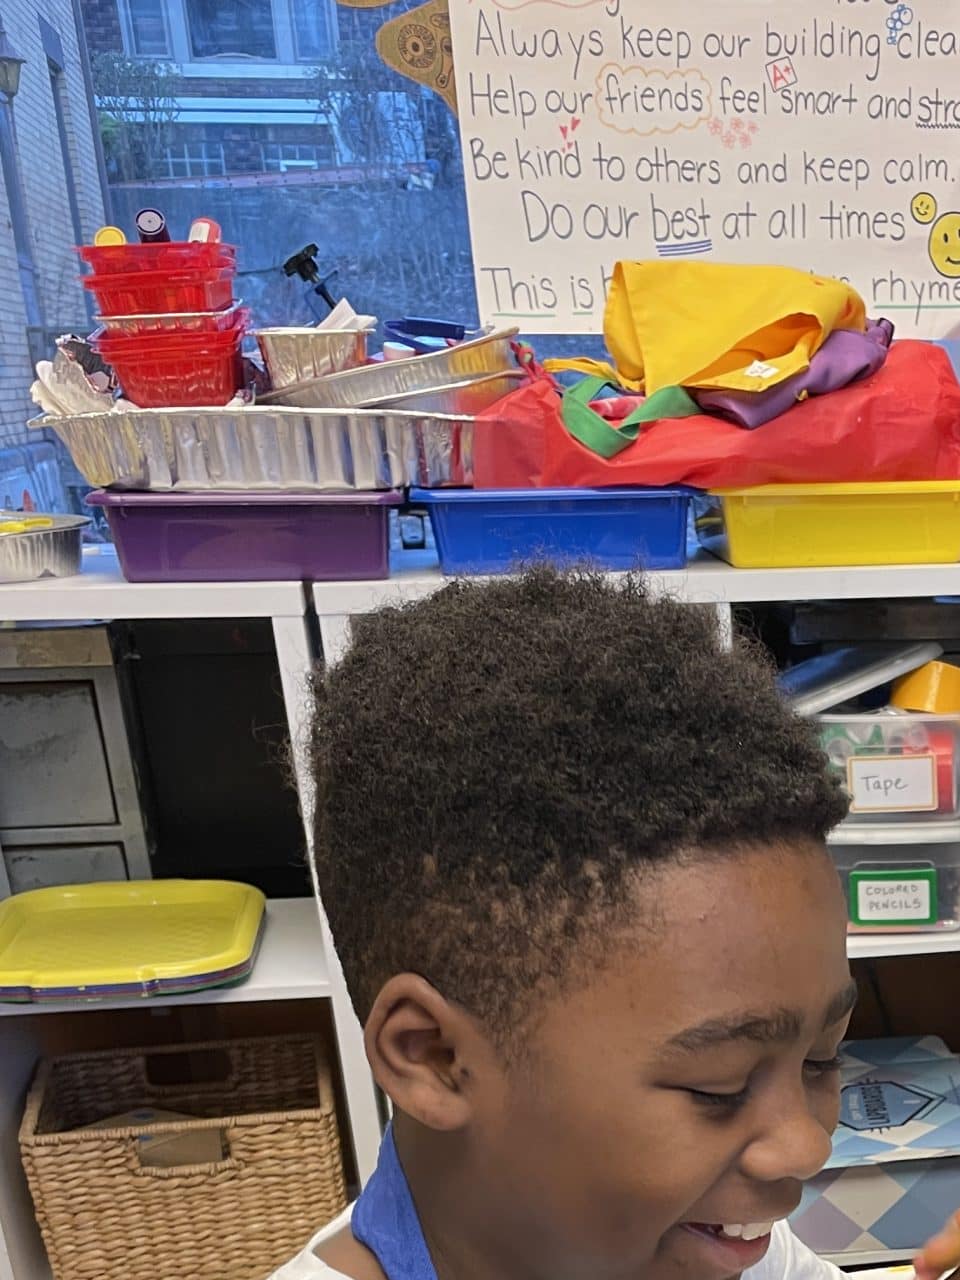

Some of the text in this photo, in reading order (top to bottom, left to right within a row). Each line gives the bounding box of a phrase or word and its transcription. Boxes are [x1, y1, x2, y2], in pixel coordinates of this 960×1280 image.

[475, 9, 604, 80] Always
[620, 16, 691, 68] keep
[703, 33, 751, 58] our
[765, 18, 881, 81] building
[468, 72, 537, 129] Help
[544, 89, 593, 115] our
[605, 73, 704, 115] friends
[718, 76, 768, 115] feel
[780, 83, 858, 116] smart
[867, 86, 912, 119] and
[469, 137, 956, 191] Be kind to others and keep calm.
[520, 190, 906, 242] Do our best at all times
[480, 267, 558, 312] This
[570, 275, 594, 309] is
[860, 775, 908, 797] Tape
